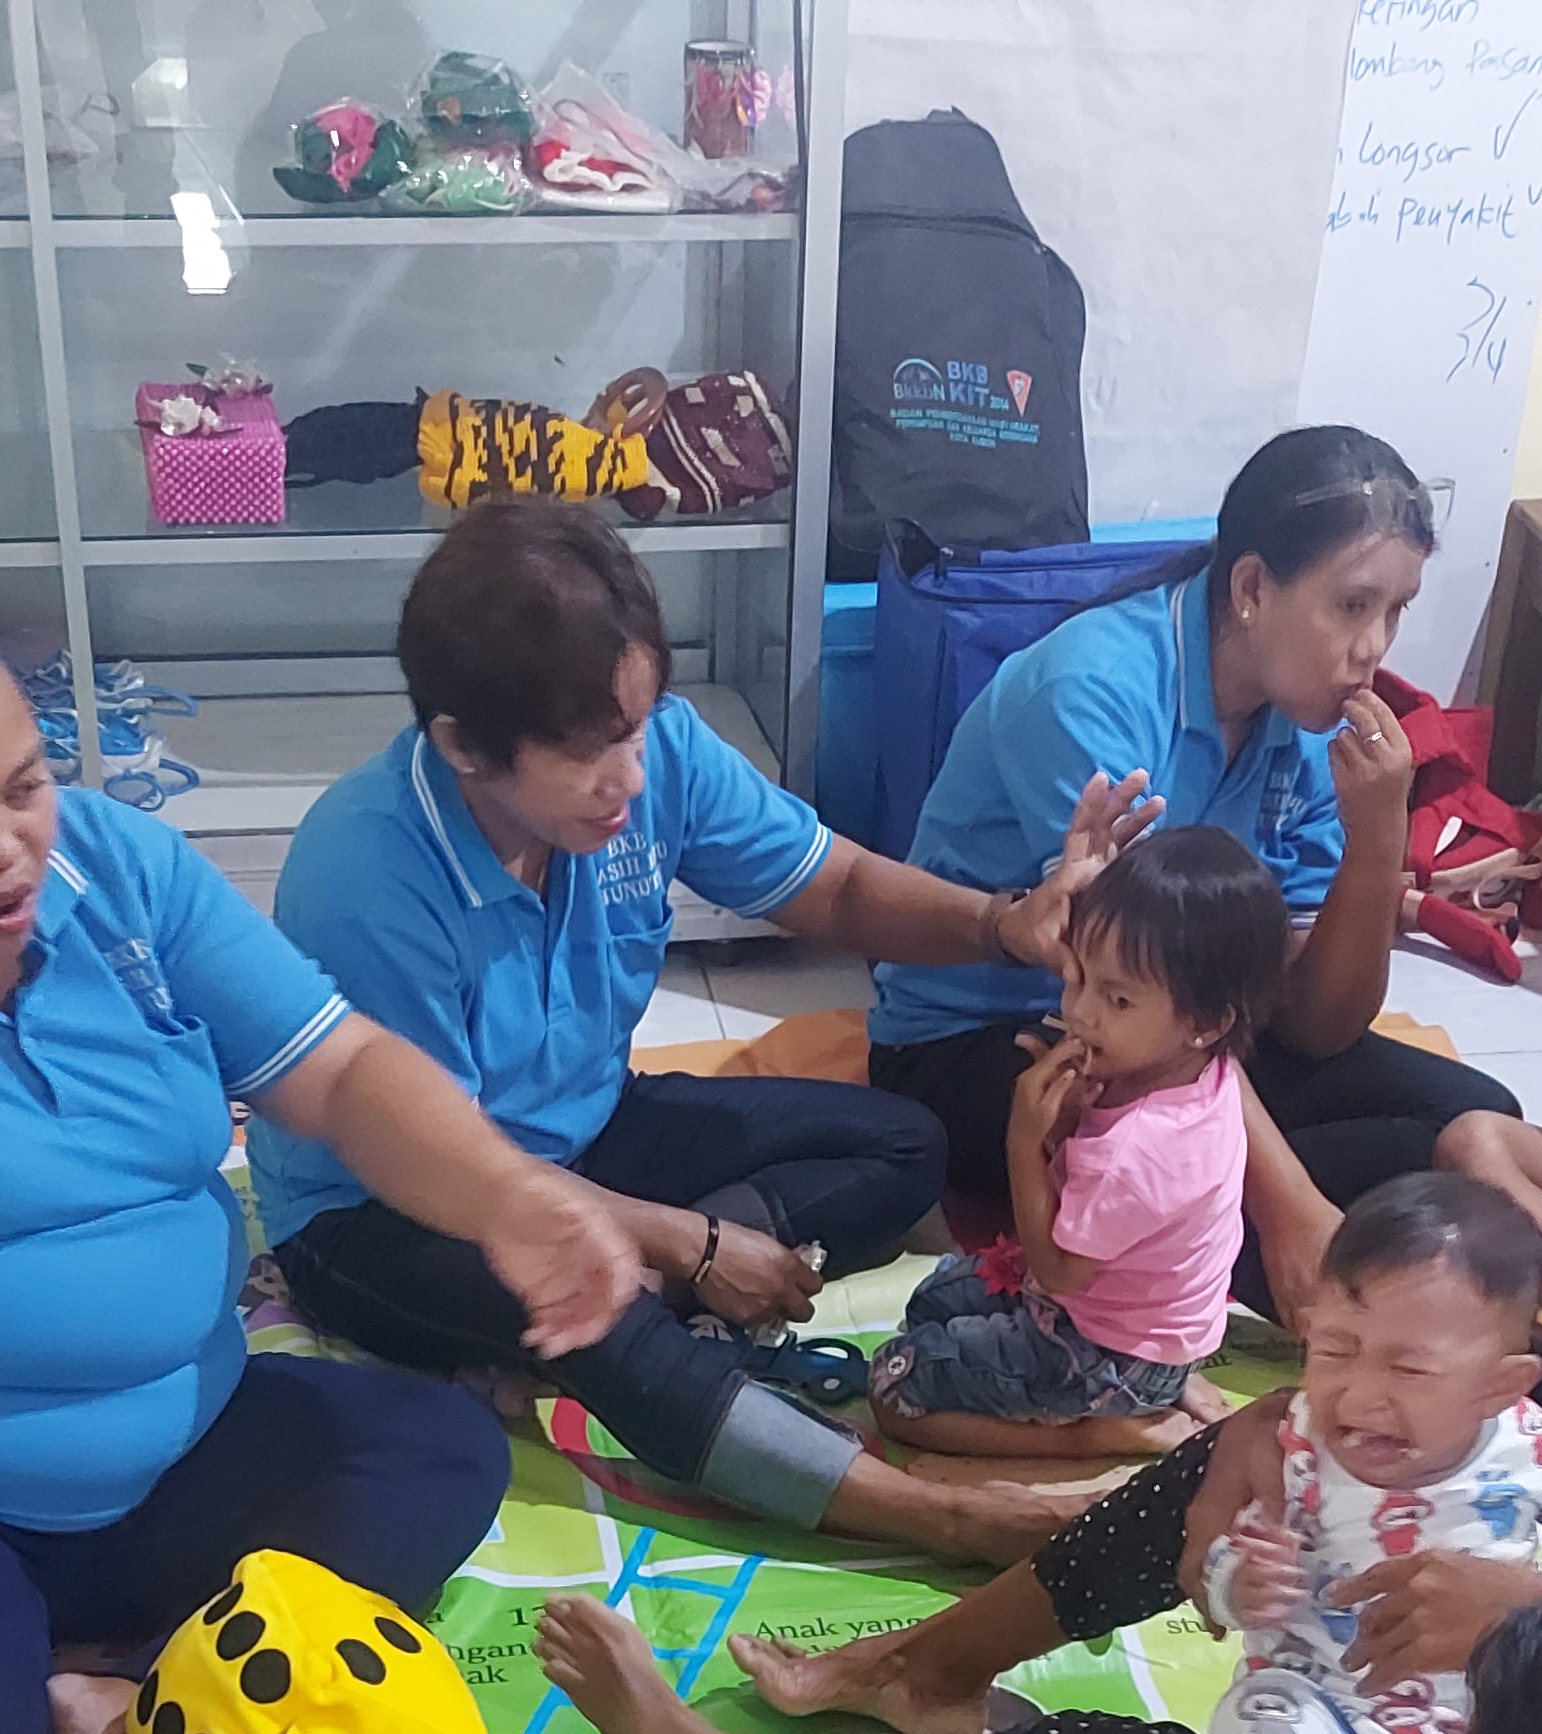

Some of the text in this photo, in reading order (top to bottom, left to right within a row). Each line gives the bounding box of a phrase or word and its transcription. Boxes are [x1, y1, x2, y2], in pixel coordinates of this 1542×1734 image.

[947, 361, 989, 384] BKB
[949, 382, 990, 408] KIT
[755, 1616, 840, 1641] Anak
